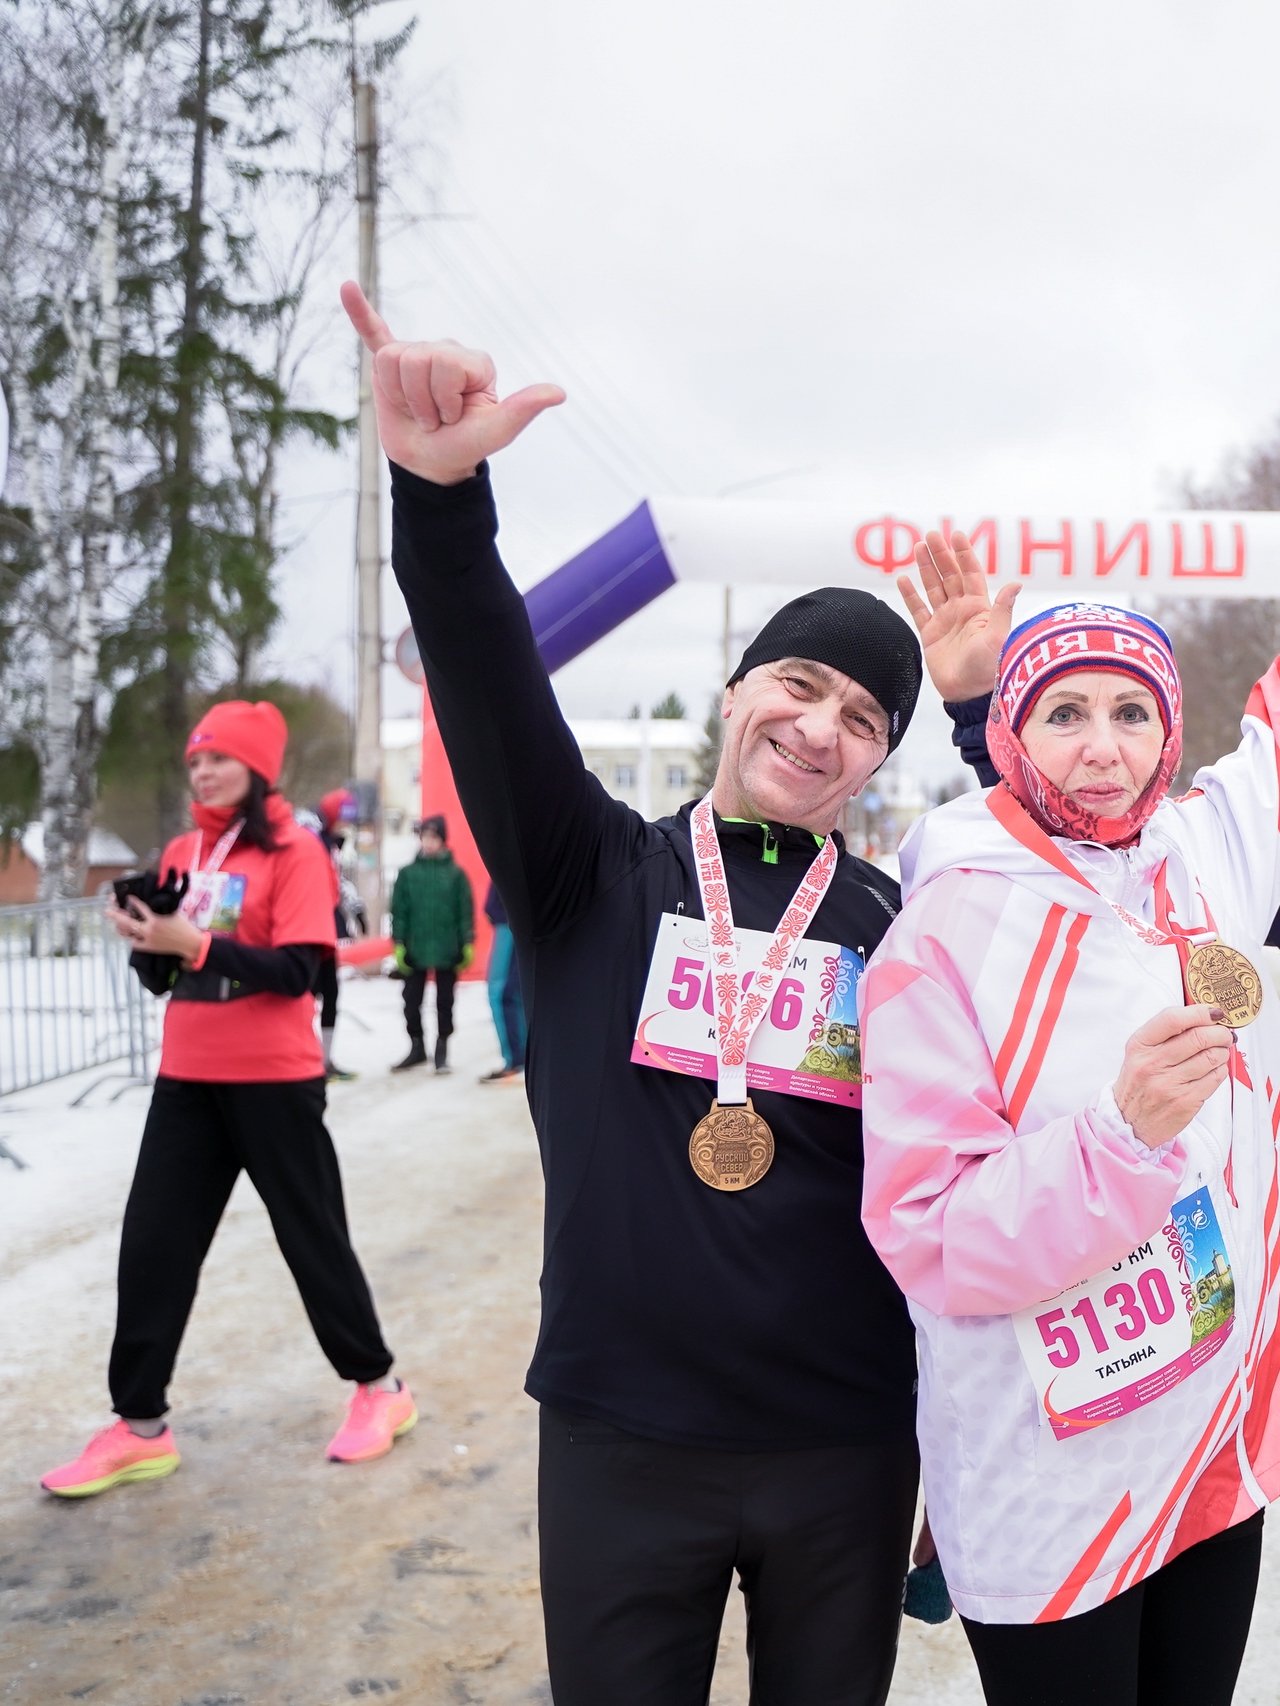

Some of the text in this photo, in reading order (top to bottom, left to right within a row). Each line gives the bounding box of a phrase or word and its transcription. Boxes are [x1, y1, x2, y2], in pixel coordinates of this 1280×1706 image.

[700, 863, 711, 882] 03.11
[711, 859, 724, 881] 2024
[793, 886, 810, 907] 03.11
[803, 892, 820, 912] 2024
[667, 956, 805, 1031] 56
[1215, 985, 1245, 1002] РУССКИЙ
[1225, 996, 1243, 1010] СЕВЕР
[1240, 1010, 1248, 1019] КМ
[715, 1151, 749, 1162] РУССКИЙ
[721, 1163, 743, 1172] СЕВЕР
[1035, 1267, 1175, 1369] 5130
[1095, 1345, 1157, 1379] ТАТЬЯНА
